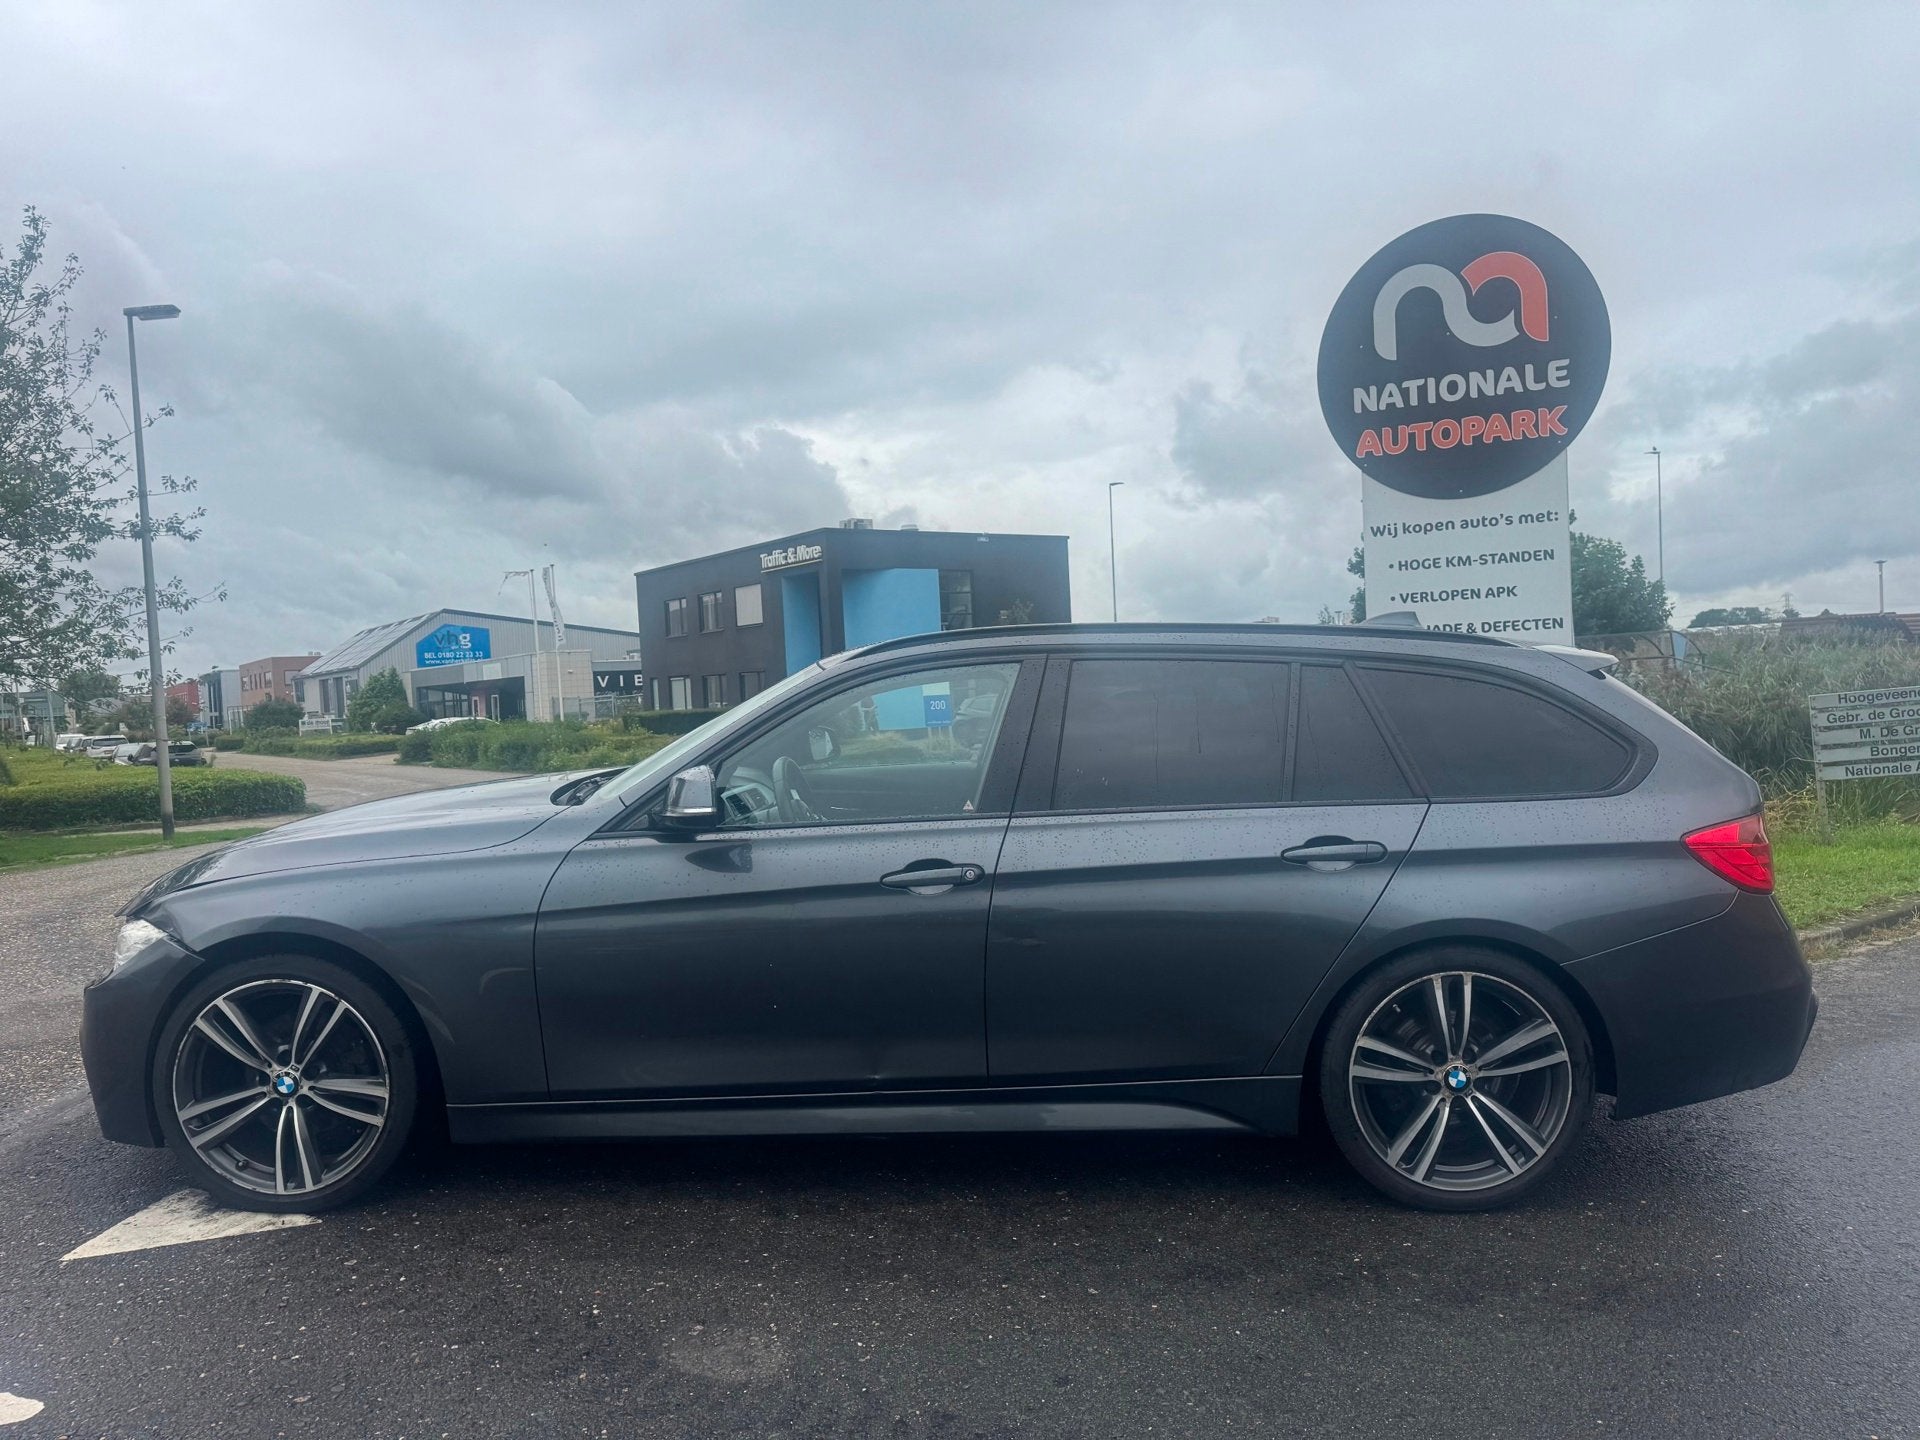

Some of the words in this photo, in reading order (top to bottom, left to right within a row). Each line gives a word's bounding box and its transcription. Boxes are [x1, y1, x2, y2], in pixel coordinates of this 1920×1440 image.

[1353, 358, 1571, 414] NATIONALE
[1355, 405, 1569, 459] AUTOPARK
[1369, 523, 1398, 539] Wij
[1402, 519, 1455, 535] kopen
[1460, 513, 1514, 529] auto's
[1518, 509, 1559, 525] met:
[760, 549, 787, 569] Traffic
[787, 547, 796, 563] &
[796, 544, 822, 561] More
[1398, 557, 1442, 572] HOGE
[1445, 548, 1555, 568] KM-STANDEN
[1399, 587, 1481, 604] VERLOPEN
[1485, 585, 1518, 599] APK
[1466, 622, 1478, 634] &
[1481, 617, 1564, 633] DEFECTEN
[929, 700, 946, 710] 200
[1827, 712, 1864, 724] Gebr.
[1868, 710, 1885, 720] de
[1859, 728, 1875, 740] M.
[1880, 727, 1898, 738] De
[1845, 762, 1912, 777] Nationale
